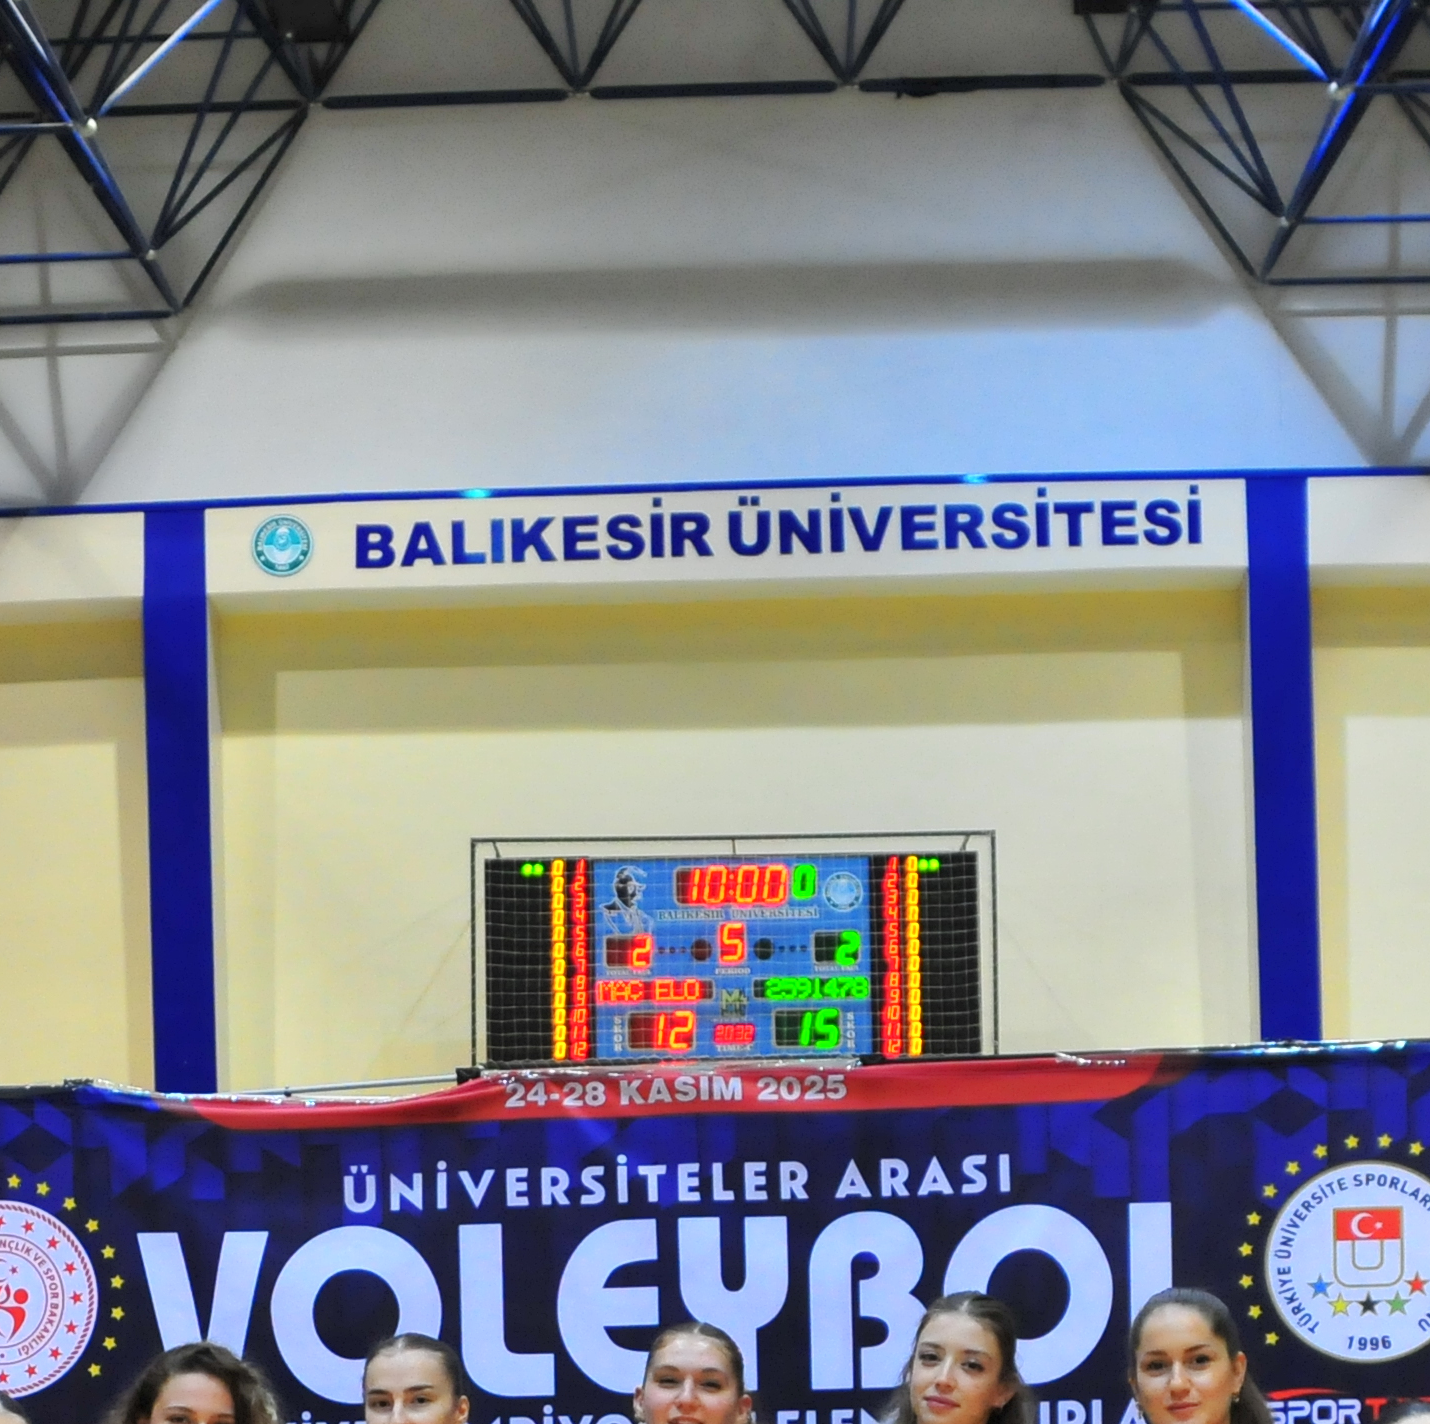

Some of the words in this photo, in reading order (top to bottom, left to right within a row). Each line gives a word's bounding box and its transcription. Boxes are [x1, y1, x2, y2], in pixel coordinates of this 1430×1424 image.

[355, 496, 711, 570] BALIKESİR
[737, 484, 1204, 556] ÜNİVERSİTESİ
[690, 864, 788, 904] 10:00
[793, 864, 816, 898] 0
[632, 934, 653, 967] 2
[721, 922, 745, 962] 5
[835, 930, 861, 965] 2
[657, 1010, 695, 1051] 12
[800, 1008, 840, 1049] 15
[504, 1080, 607, 1108] 24-28
[618, 1074, 744, 1106] KASIM
[757, 1074, 848, 1102] 2025
[343, 1153, 810, 1214] ÜNİVERSİTELER
[835, 1152, 1012, 1198] ARASI
[1274, 1176, 1349, 1260] ÜNİVERSİTE
[33, 1252, 46, 1267] VE
[43, 1267, 59, 1300] SPOR
[1277, 1266, 1320, 1334] TÜRKİYE
[18, 1302, 59, 1357] BAKANLIĞI
[1347, 1335, 1393, 1351] 1996
